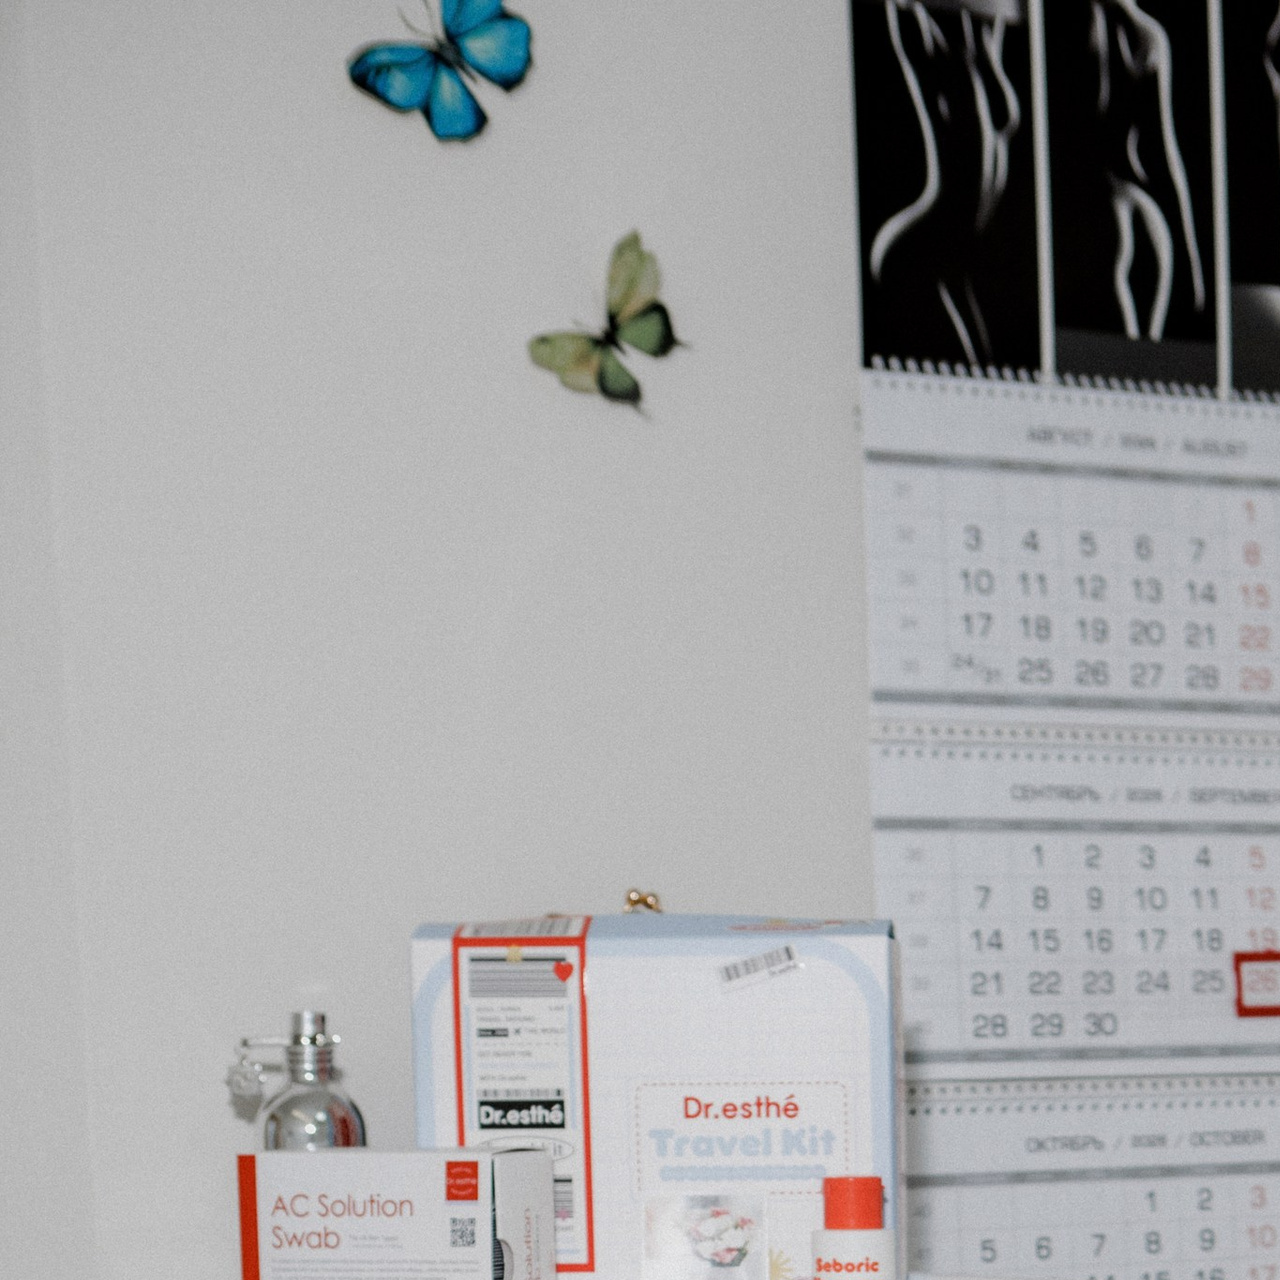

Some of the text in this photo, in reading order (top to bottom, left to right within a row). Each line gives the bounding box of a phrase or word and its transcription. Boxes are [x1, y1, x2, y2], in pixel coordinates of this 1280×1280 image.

[1243, 501, 1256, 522] 1
[963, 524, 984, 552] 3
[1020, 529, 1042, 553] 4
[1078, 530, 1099, 558] 5
[1133, 534, 1155, 562] 6
[1189, 538, 1208, 561] 7
[959, 568, 996, 596] 10
[1017, 571, 1049, 596] 11
[1073, 574, 1108, 601] 12
[1131, 577, 1164, 605] 13
[1185, 580, 1219, 605] 14
[1240, 583, 1271, 609] 15
[960, 612, 995, 637] 17
[1018, 614, 1053, 642] 18
[1075, 617, 1111, 645] 19
[1128, 619, 1167, 647] 20
[1184, 622, 1217, 649] 21
[1238, 624, 1271, 651] 22
[1017, 657, 1055, 684] 25
[1074, 659, 1110, 686] 26
[1130, 662, 1165, 687] 27
[1186, 664, 1220, 689] 28
[1241, 667, 1273, 690] 29
[1031, 844, 1045, 866] 1
[1084, 844, 1103, 870] 2
[1139, 845, 1157, 870] 3
[1193, 845, 1214, 868] 4
[1248, 846, 1266, 870] 5
[974, 885, 993, 910] 7
[1031, 885, 1052, 912] 8
[1085, 886, 1106, 912] 9
[1134, 886, 1169, 912] 10
[1190, 887, 1220, 909] 11
[1245, 887, 1276, 911] 12
[970, 928, 1005, 952] 14
[1027, 928, 1062, 954] 15
[1082, 927, 1115, 954] 16
[1135, 928, 1169, 951] 17
[1192, 927, 1225, 953] 18
[1246, 929, 1279, 953] 19
[969, 971, 1005, 997] 21
[1027, 970, 1063, 996] 22
[1082, 969, 1116, 996] 23
[1135, 970, 1172, 995] 24
[1191, 969, 1224, 994] 25
[1246, 968, 1280, 992] 26
[971, 1012, 1119, 1038] 28 29 30
[480, 1104, 564, 1125] Dr.esthé
[684, 1094, 799, 1119] Dr.esthé
[649, 1125, 837, 1157] Travel Kit
[1023, 1135, 1104, 1153] ОКТЯБРЬ
[1188, 1129, 1266, 1147] OCTOBER
[271, 1193, 414, 1218] AC Solution
[1144, 1190, 1158, 1212] 1
[1196, 1187, 1215, 1212] 2
[1250, 1185, 1268, 1209] 3
[271, 1226, 341, 1249] Swab
[978, 1238, 999, 1264] 5
[1034, 1235, 1054, 1261] 6
[1090, 1232, 1108, 1257] 7
[1143, 1230, 1164, 1255] 8
[1197, 1227, 1218, 1253] 9
[1246, 1224, 1278, 1249] 10
[815, 1257, 880, 1273] Seboric
